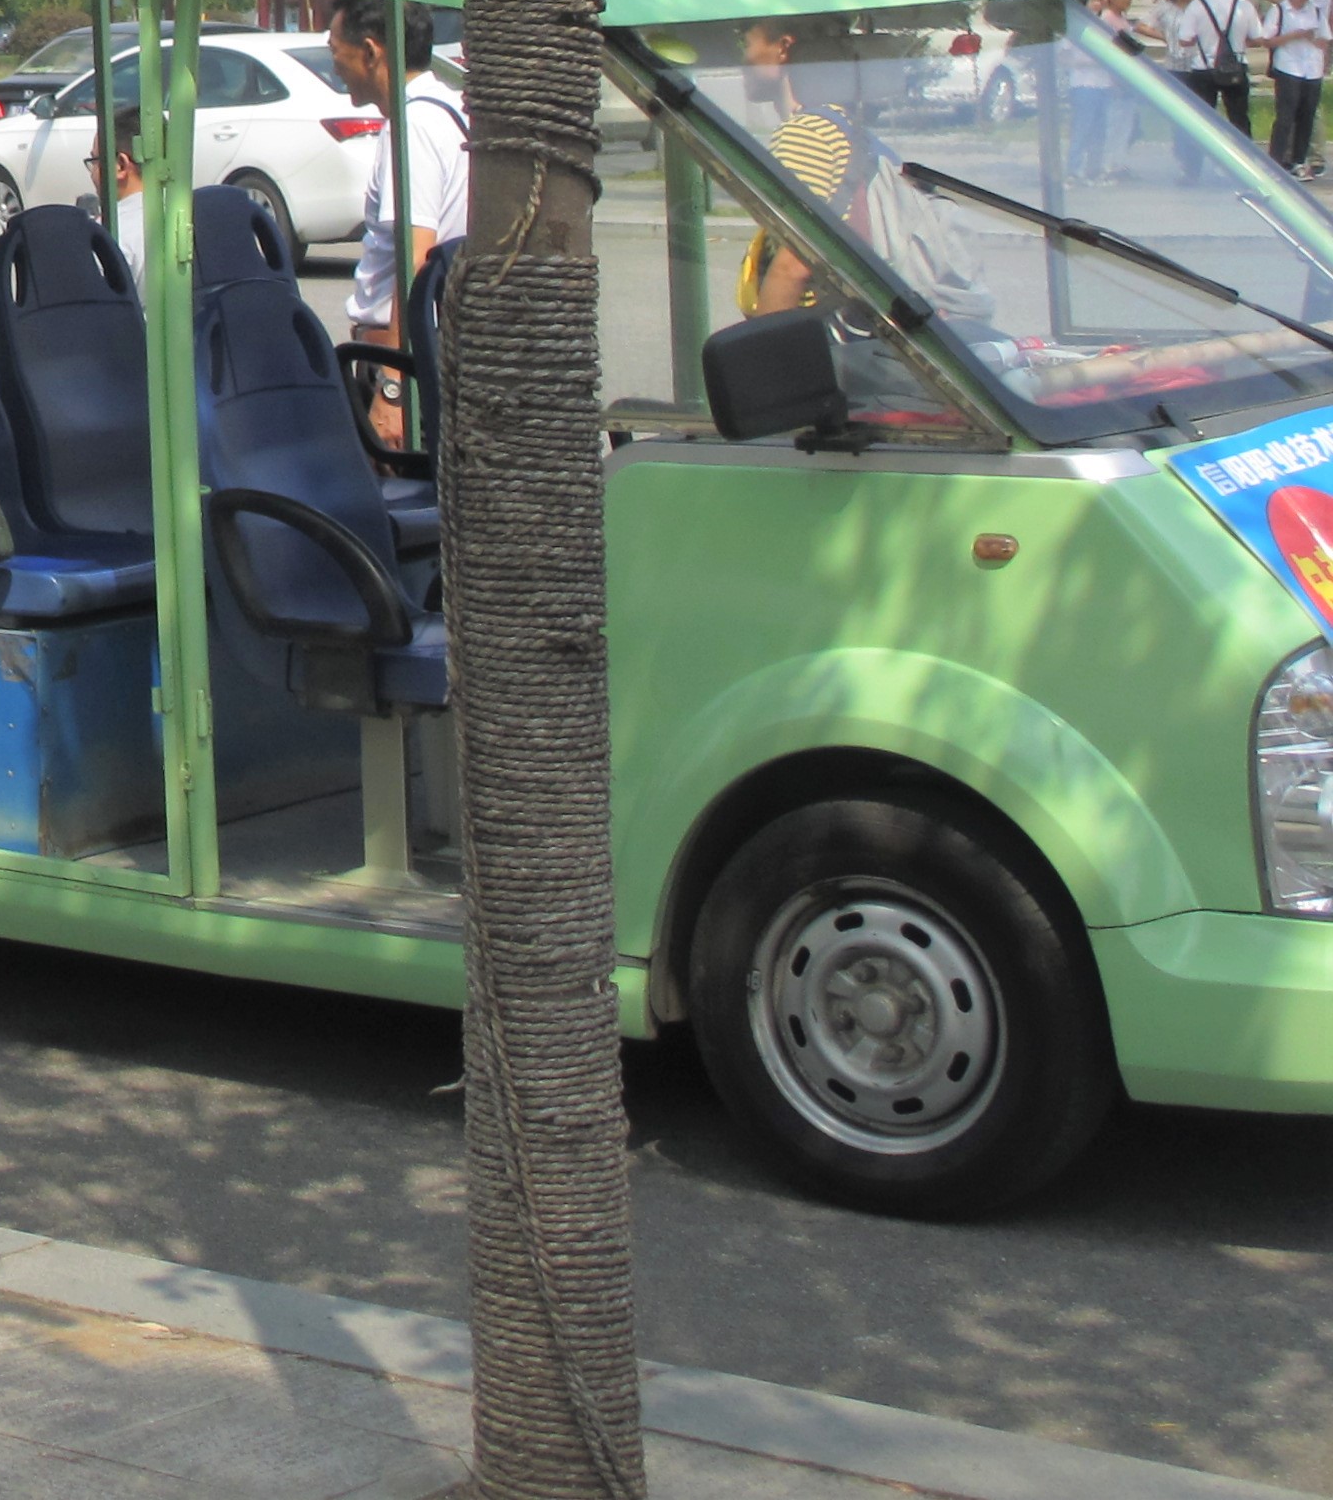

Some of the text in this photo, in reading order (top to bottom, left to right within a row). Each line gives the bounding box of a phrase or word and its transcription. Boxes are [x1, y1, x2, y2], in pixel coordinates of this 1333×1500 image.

[1194, 422, 1333, 496] 信阳职业技术
